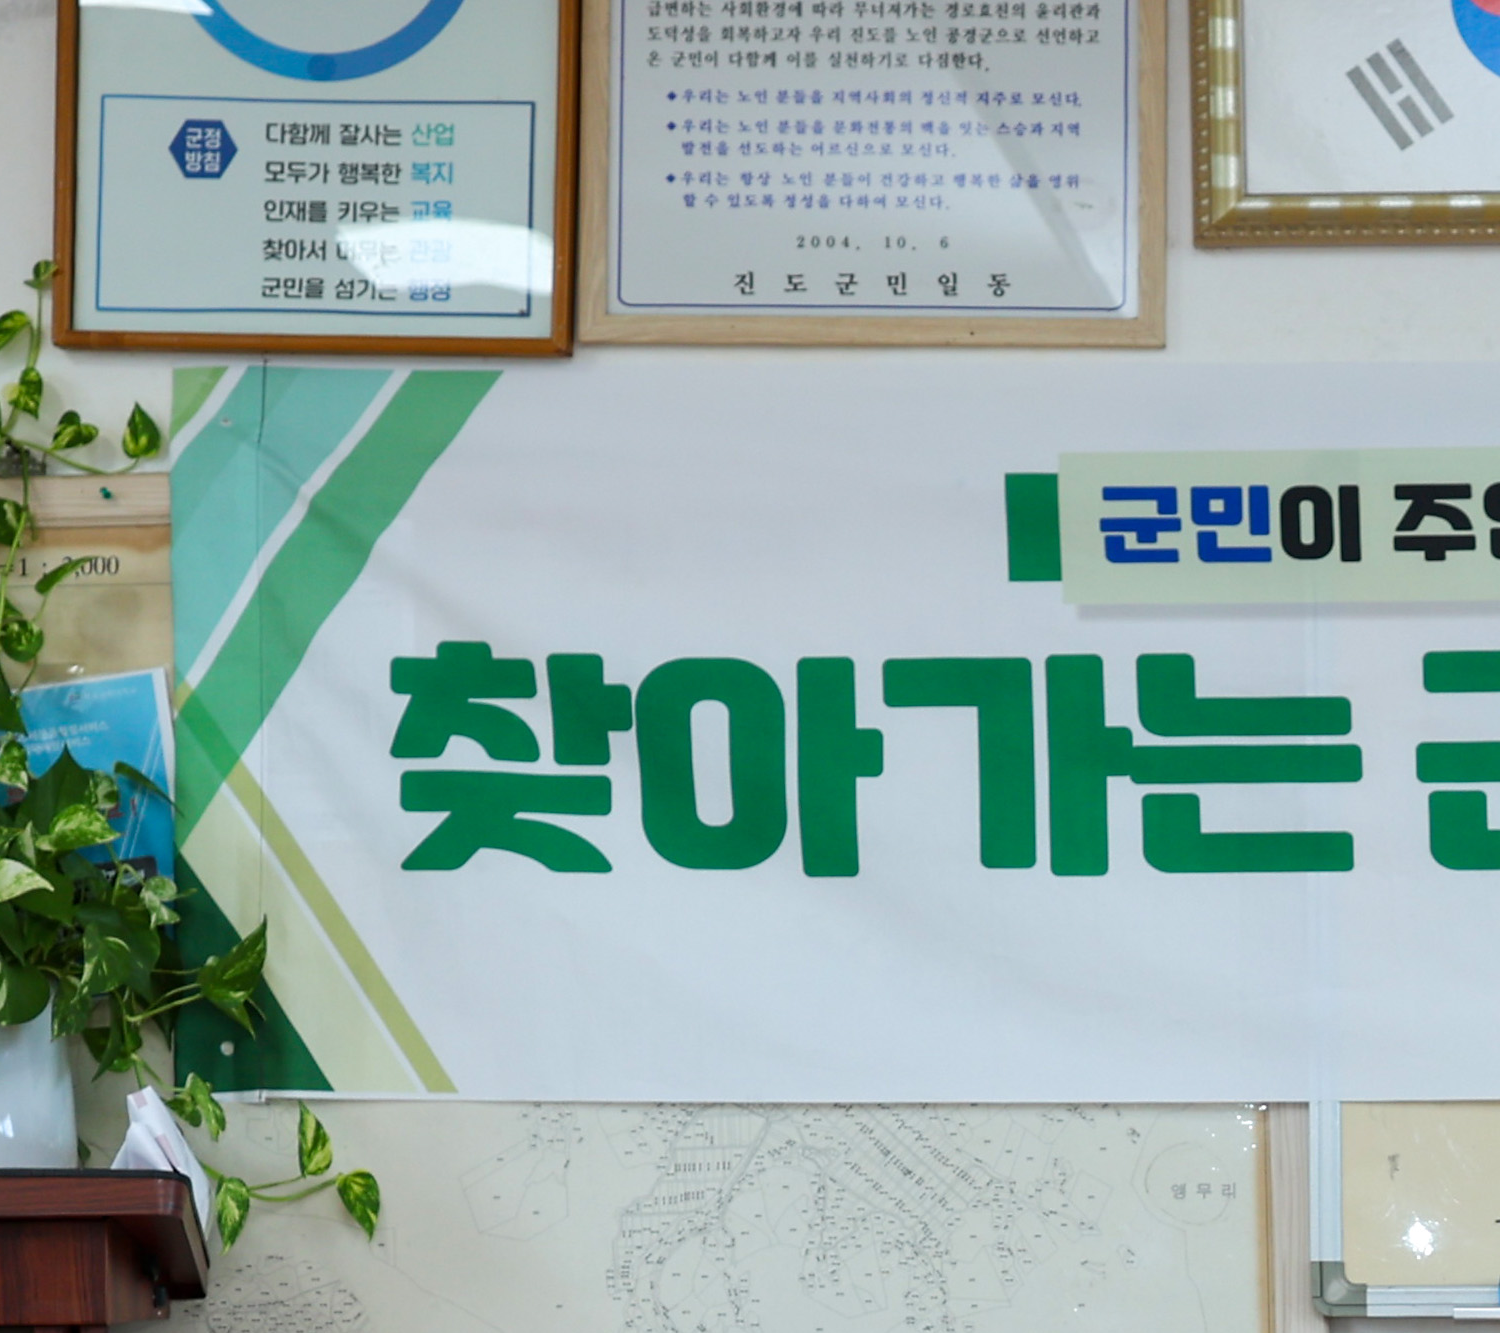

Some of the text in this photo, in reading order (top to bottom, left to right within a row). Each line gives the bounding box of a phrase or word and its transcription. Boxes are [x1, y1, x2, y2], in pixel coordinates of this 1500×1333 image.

[810, 26, 841, 43] 우리
[850, 26, 897, 43] 진도를
[906, 27, 937, 43] 노인
[1036, 28, 1100, 44] 선언하고
[672, 51, 719, 68] 군민이
[729, 51, 777, 68] 다함께
[786, 51, 817, 68] 이를
[828, 52, 908, 68] 실천하기로
[683, 89, 729, 104] 우리는
[738, 89, 768, 104] 노인
[265, 123, 455, 147] 다함께 잘사는 산업
[683, 119, 729, 134] 우리는
[738, 119, 768, 134] 노인
[185, 128, 222, 148] 군정
[264, 161, 454, 185] 모두가 행복한 복지
[682, 171, 729, 186] 우리는
[263, 200, 453, 223] 인재를 키우는 교육
[262, 239, 327, 261] 찾아서
[261, 277, 324, 299] 군민을
[1100, 484, 1363, 565] 군민이
[389, 640, 1364, 878] 찾아가는
